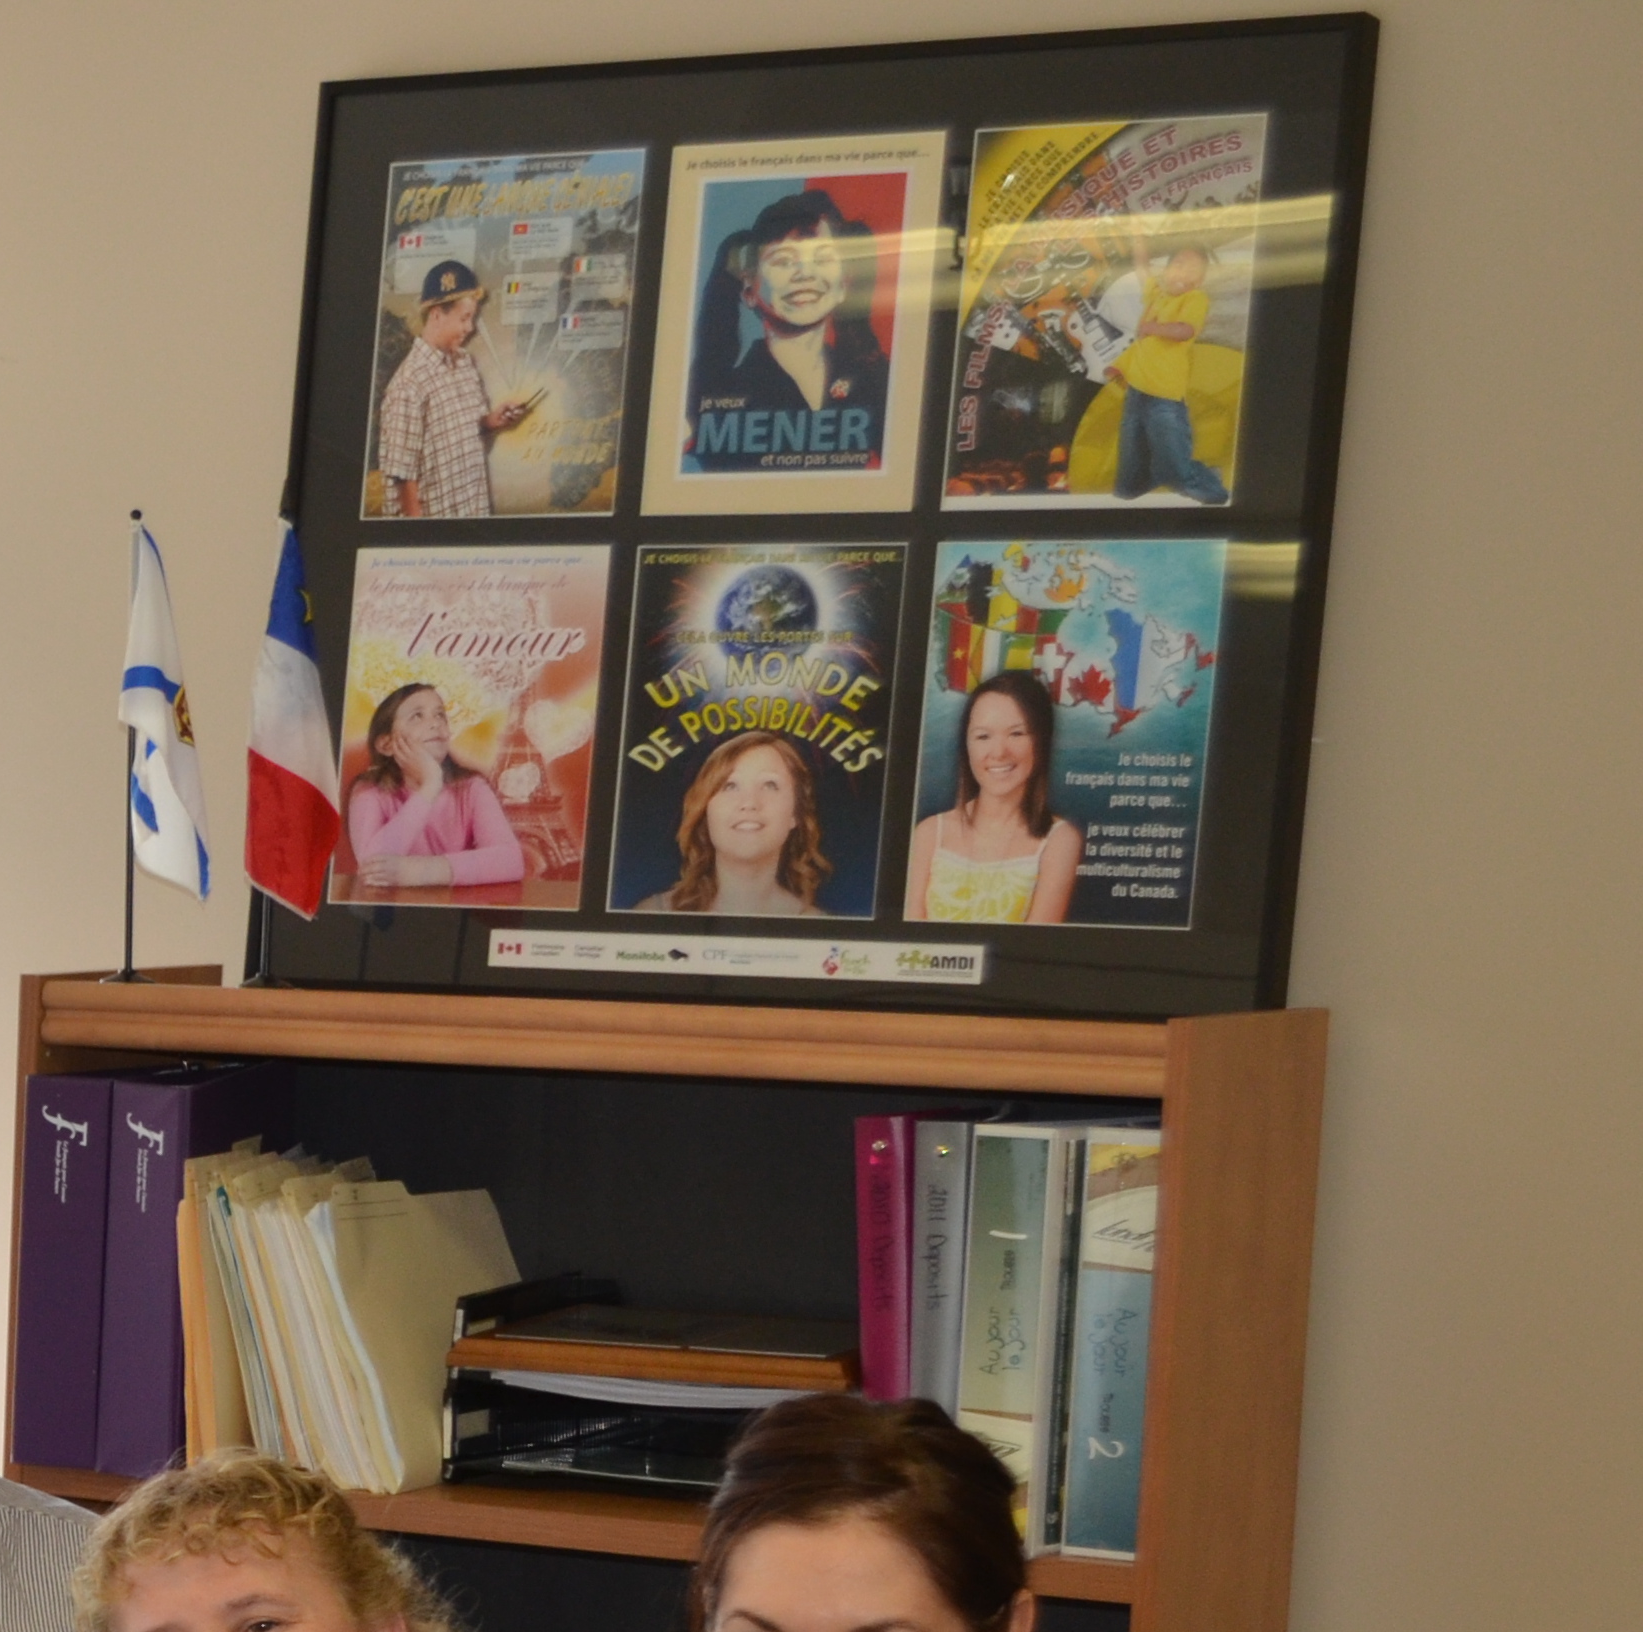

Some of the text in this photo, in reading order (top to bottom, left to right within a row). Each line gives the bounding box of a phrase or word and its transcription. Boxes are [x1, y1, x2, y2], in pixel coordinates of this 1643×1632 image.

[699, 157, 736, 170] choisis
[738, 157, 750, 168] le
[750, 154, 793, 168] français
[795, 153, 822, 165] dans
[844, 151, 861, 162] vie
[863, 150, 894, 163] parce
[1104, 132, 1244, 211] HISTOIRES
[1167, 157, 1255, 196] FRANÇAIS
[957, 395, 978, 451] LES
[1142, 124, 1179, 157] ET
[698, 395, 746, 412] je veux
[695, 407, 871, 455] MENER
[760, 452, 868, 468] et non pas suivre
[405, 609, 584, 658] l'amour
[644, 651, 882, 712] UN MONDE
[627, 696, 885, 773] DE POSSIBILITÉS
[1117, 752, 1193, 768] Je choisis le
[1065, 771, 1191, 789] français dans ma vie
[1109, 794, 1145, 808] parce
[1086, 823, 1187, 839] je veux célébrer
[1085, 843, 1183, 859] la diversité et le
[1075, 863, 1182, 879] multiculturalisme
[1111, 883, 1179, 899] du Canada.
[616, 950, 666, 962] Manitoba
[929, 955, 974, 971] AMDI
[921, 1184, 949, 1311] 2011 Deposits
[978, 1349, 1001, 1376] Au
[1087, 1436, 1128, 1460] 2
